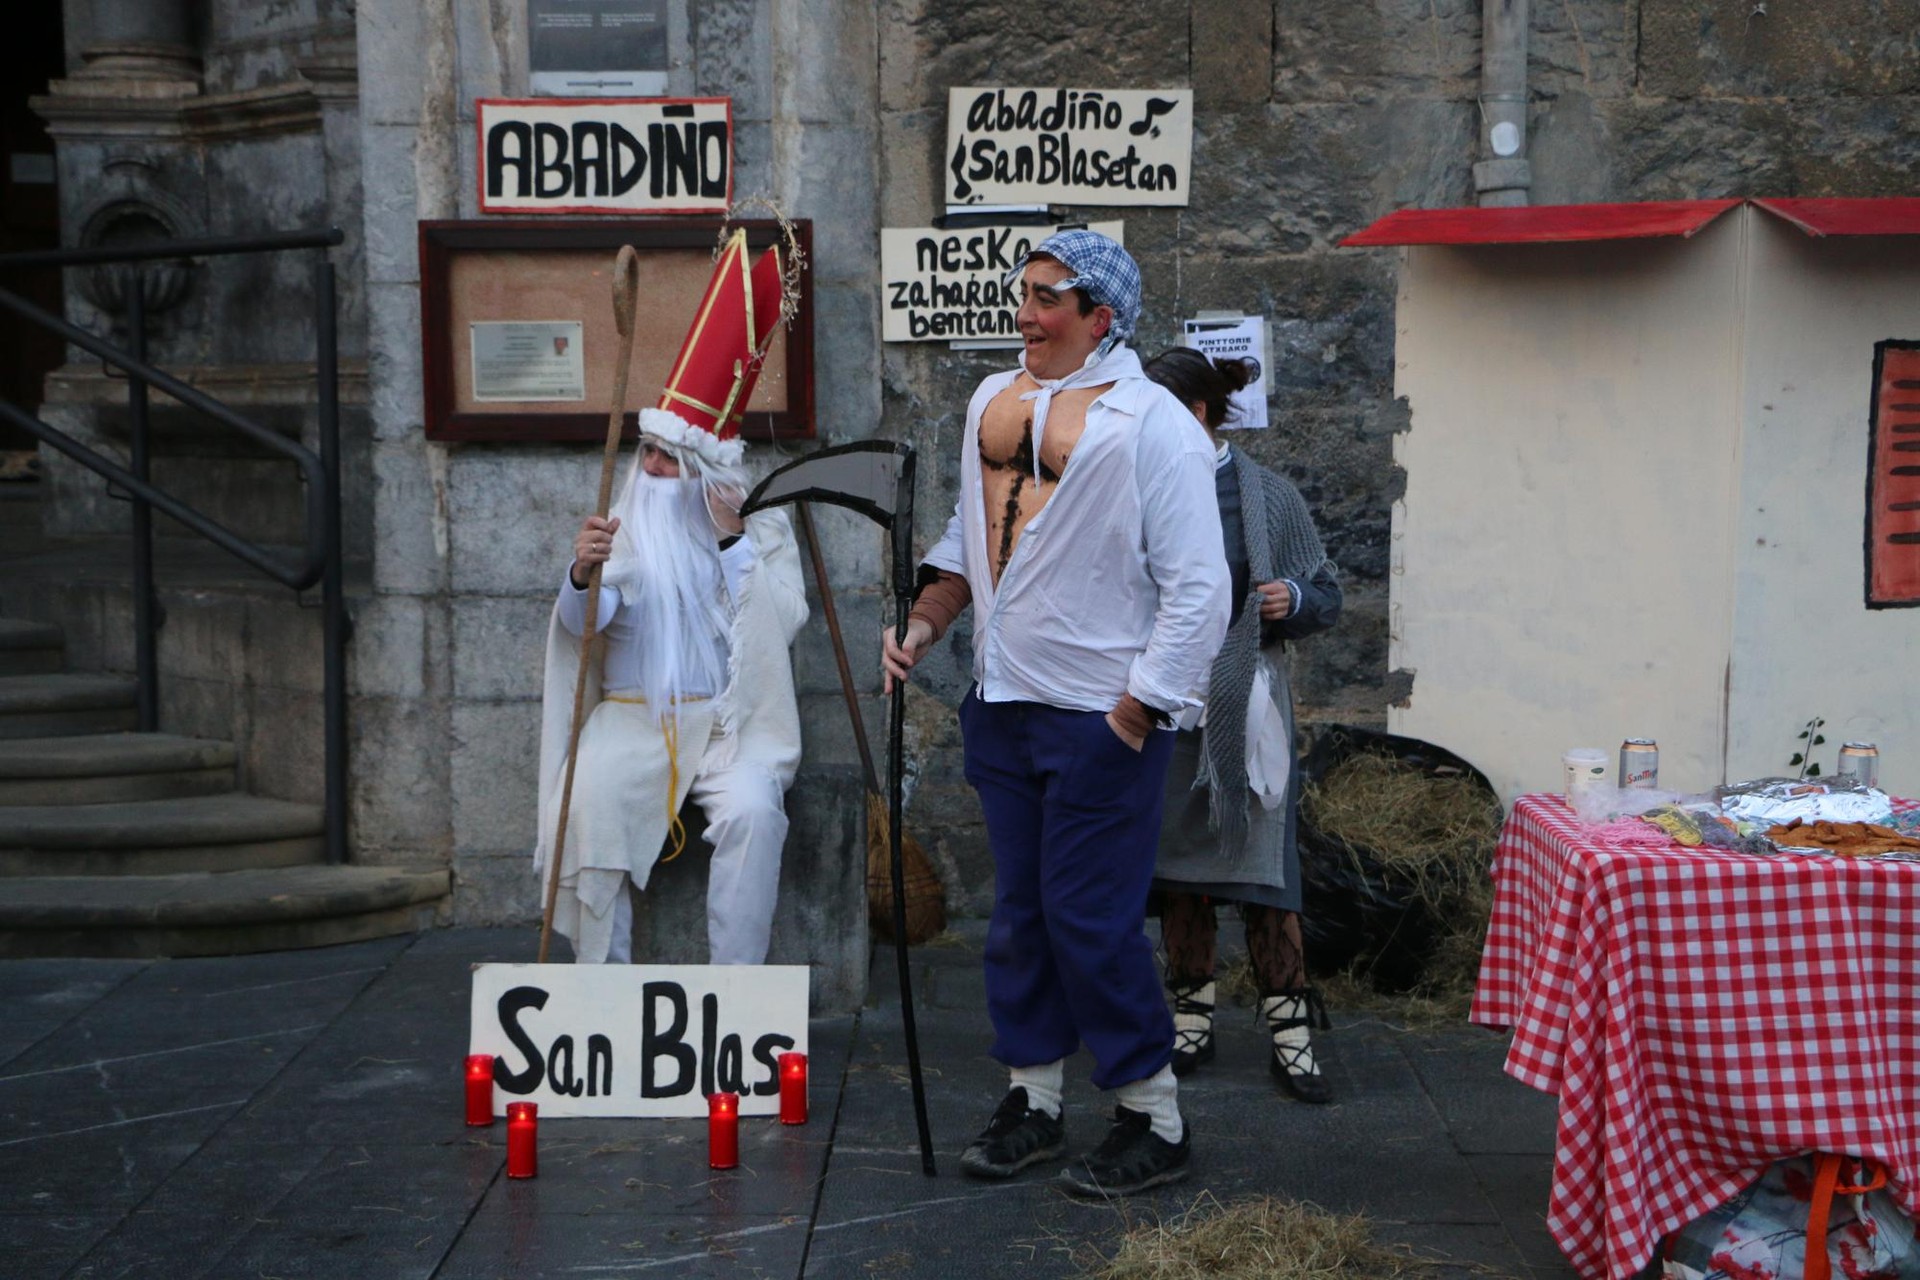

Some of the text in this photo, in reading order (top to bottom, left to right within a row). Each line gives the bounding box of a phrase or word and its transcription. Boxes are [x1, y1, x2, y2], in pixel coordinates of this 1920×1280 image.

[487, 104, 728, 199] ABADIÑO
[1198, 337, 1251, 346] PINTTORIE
[1202, 345, 1248, 353] ETXEAKO
[493, 981, 795, 1098] San Blas
